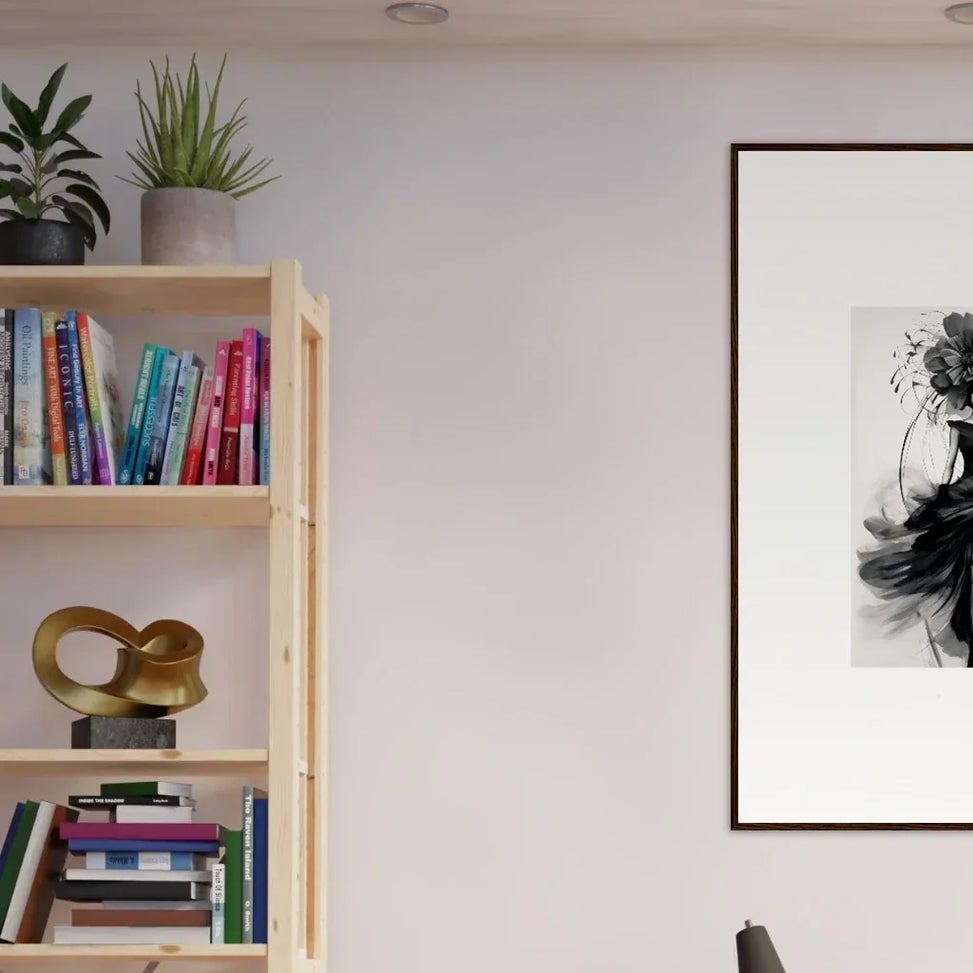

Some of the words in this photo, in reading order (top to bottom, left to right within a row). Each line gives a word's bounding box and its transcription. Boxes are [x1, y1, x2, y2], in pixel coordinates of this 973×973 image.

[22, 325, 32, 339] Oil
[47, 347, 56, 363] FINE
[80, 327, 95, 375] Watercolor
[19, 342, 32, 385] Paintings
[48, 364, 57, 379] ART
[58, 345, 74, 408] ICONIC
[50, 384, 58, 402] With
[86, 376, 100, 411] Portraits
[49, 402, 60, 425] Digital
[53, 426, 63, 443] Tools
[215, 868, 223, 884] Touch
[215, 884, 223, 892] Of
